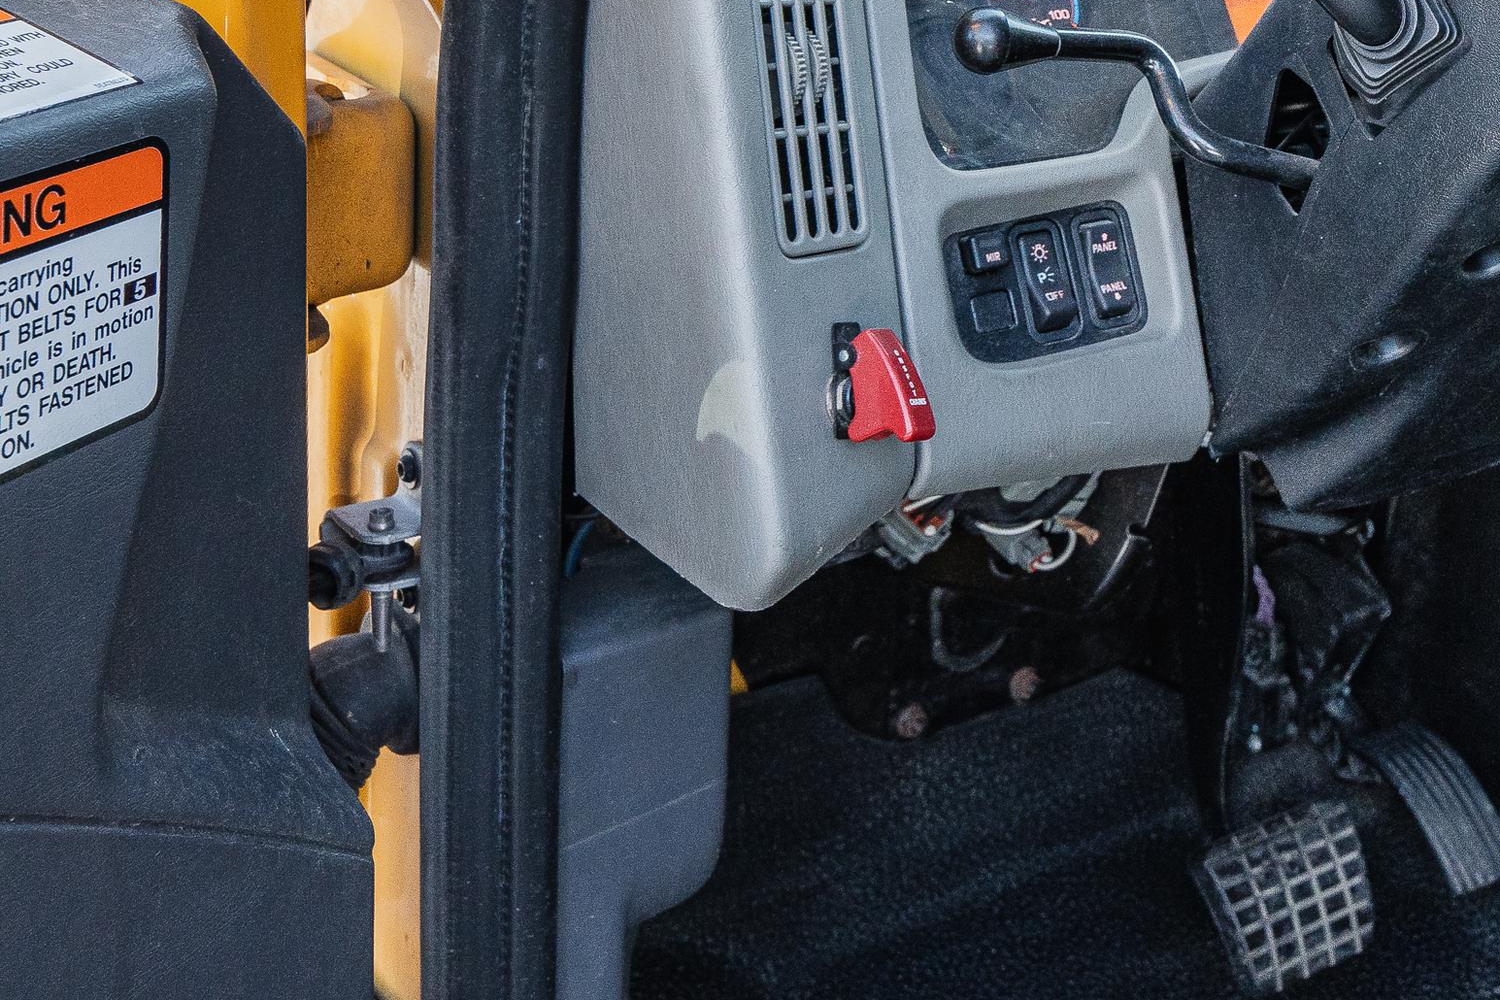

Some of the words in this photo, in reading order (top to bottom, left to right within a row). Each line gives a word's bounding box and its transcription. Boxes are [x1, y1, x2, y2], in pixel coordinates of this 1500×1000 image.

[1048, 9, 1070, 20] 100
[8, 31, 46, 43] WITH
[27, 58, 74, 74] COULD
[3, 184, 66, 244] NG
[1092, 240, 1118, 254] PANEL
[0, 257, 73, 297] carrying
[48, 270, 99, 305] ONLY.
[107, 256, 142, 283] This
[1100, 280, 1128, 294] PANEL
[18, 305, 76, 345] BELTS
[85, 288, 121, 318] FOR
[133, 278, 146, 300] 5
[1044, 289, 1064, 302] OFF
[48, 340, 63, 360] is
[71, 331, 86, 350] in
[95, 305, 153, 341] motion
[17, 371, 44, 399] OR
[53, 342, 117, 385] DEATH.
[39, 361, 133, 418] FASTENED
[1, 430, 35, 460] ON.
